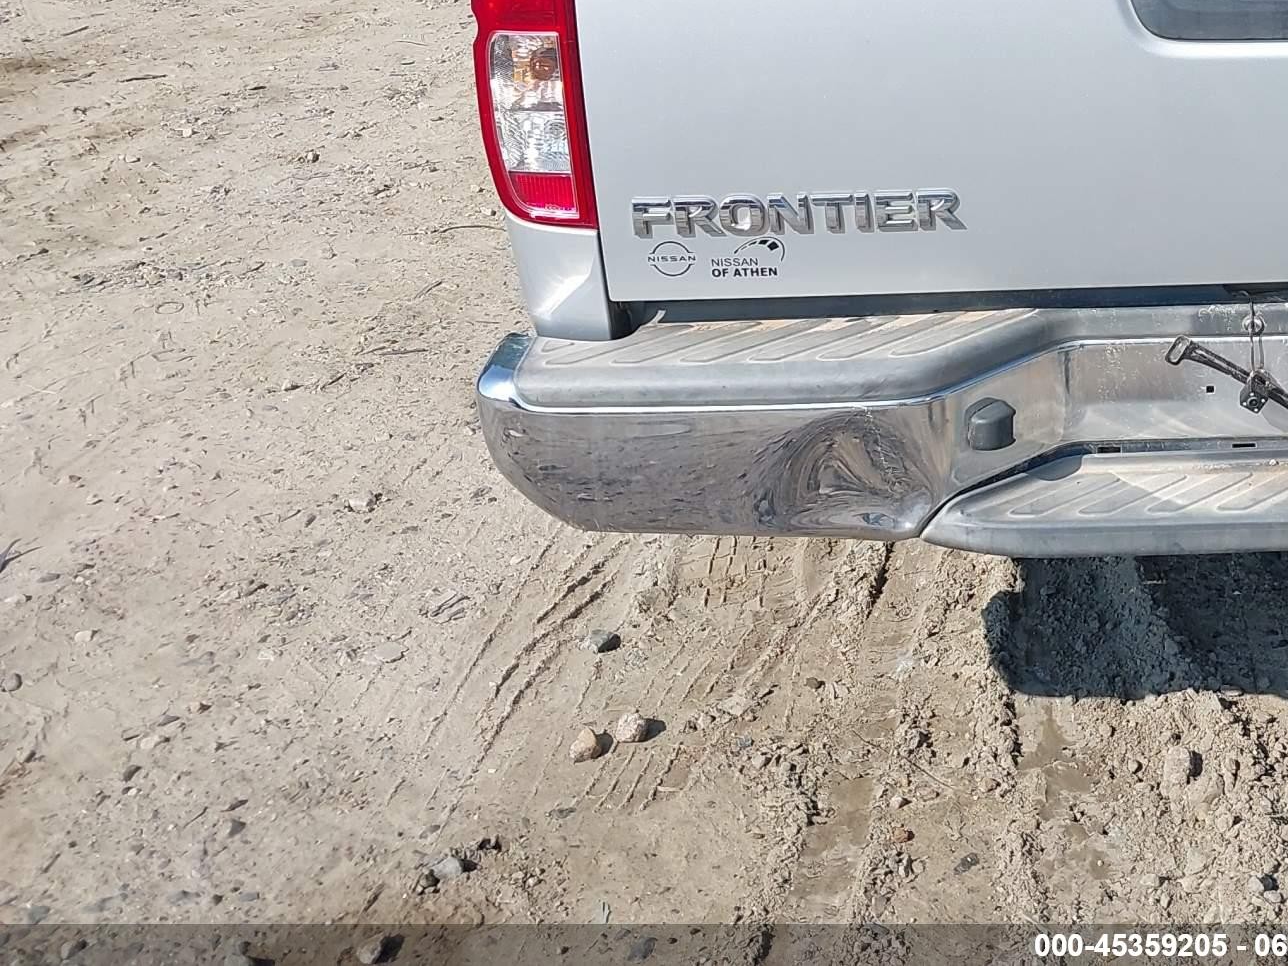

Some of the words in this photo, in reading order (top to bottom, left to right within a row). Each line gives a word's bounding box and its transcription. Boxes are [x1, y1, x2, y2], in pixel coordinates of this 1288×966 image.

[631, 187, 967, 239] FRONTIER
[647, 254, 697, 264] NISSAN
[711, 256, 759, 267] NISSAN
[711, 268, 730, 278] OF
[733, 267, 778, 278] ATHEN
